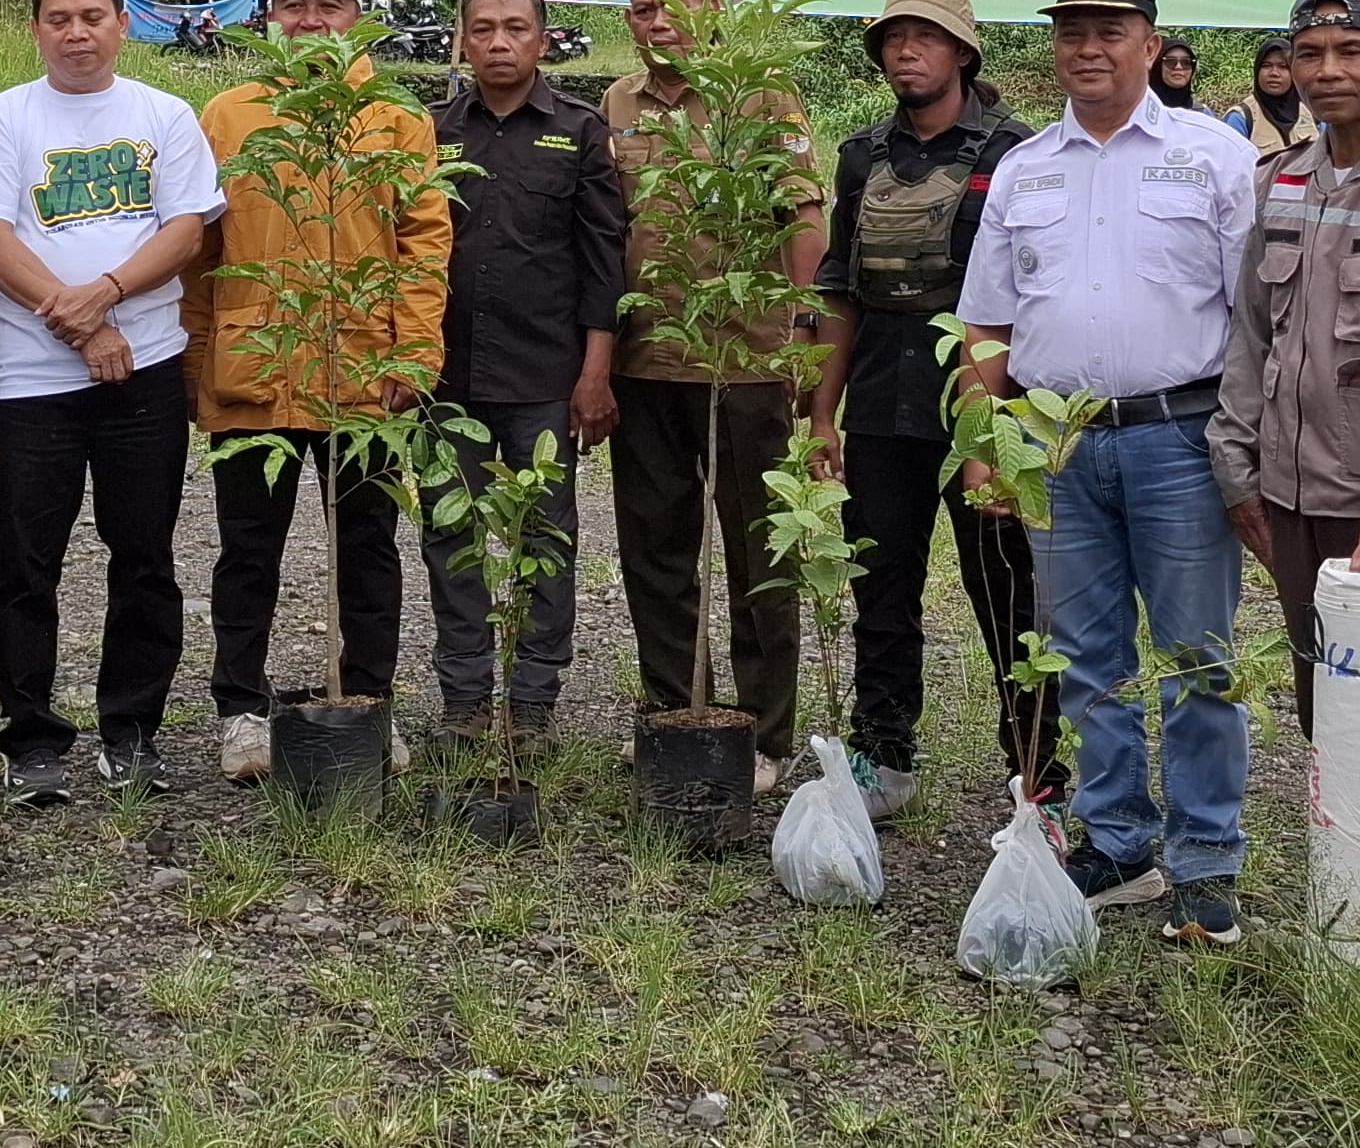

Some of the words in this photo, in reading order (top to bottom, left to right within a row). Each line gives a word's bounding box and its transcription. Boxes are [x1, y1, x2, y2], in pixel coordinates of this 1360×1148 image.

[48, 142, 135, 182] ZERO
[1147, 169, 1204, 183] KADES
[35, 170, 152, 219] WASTE
